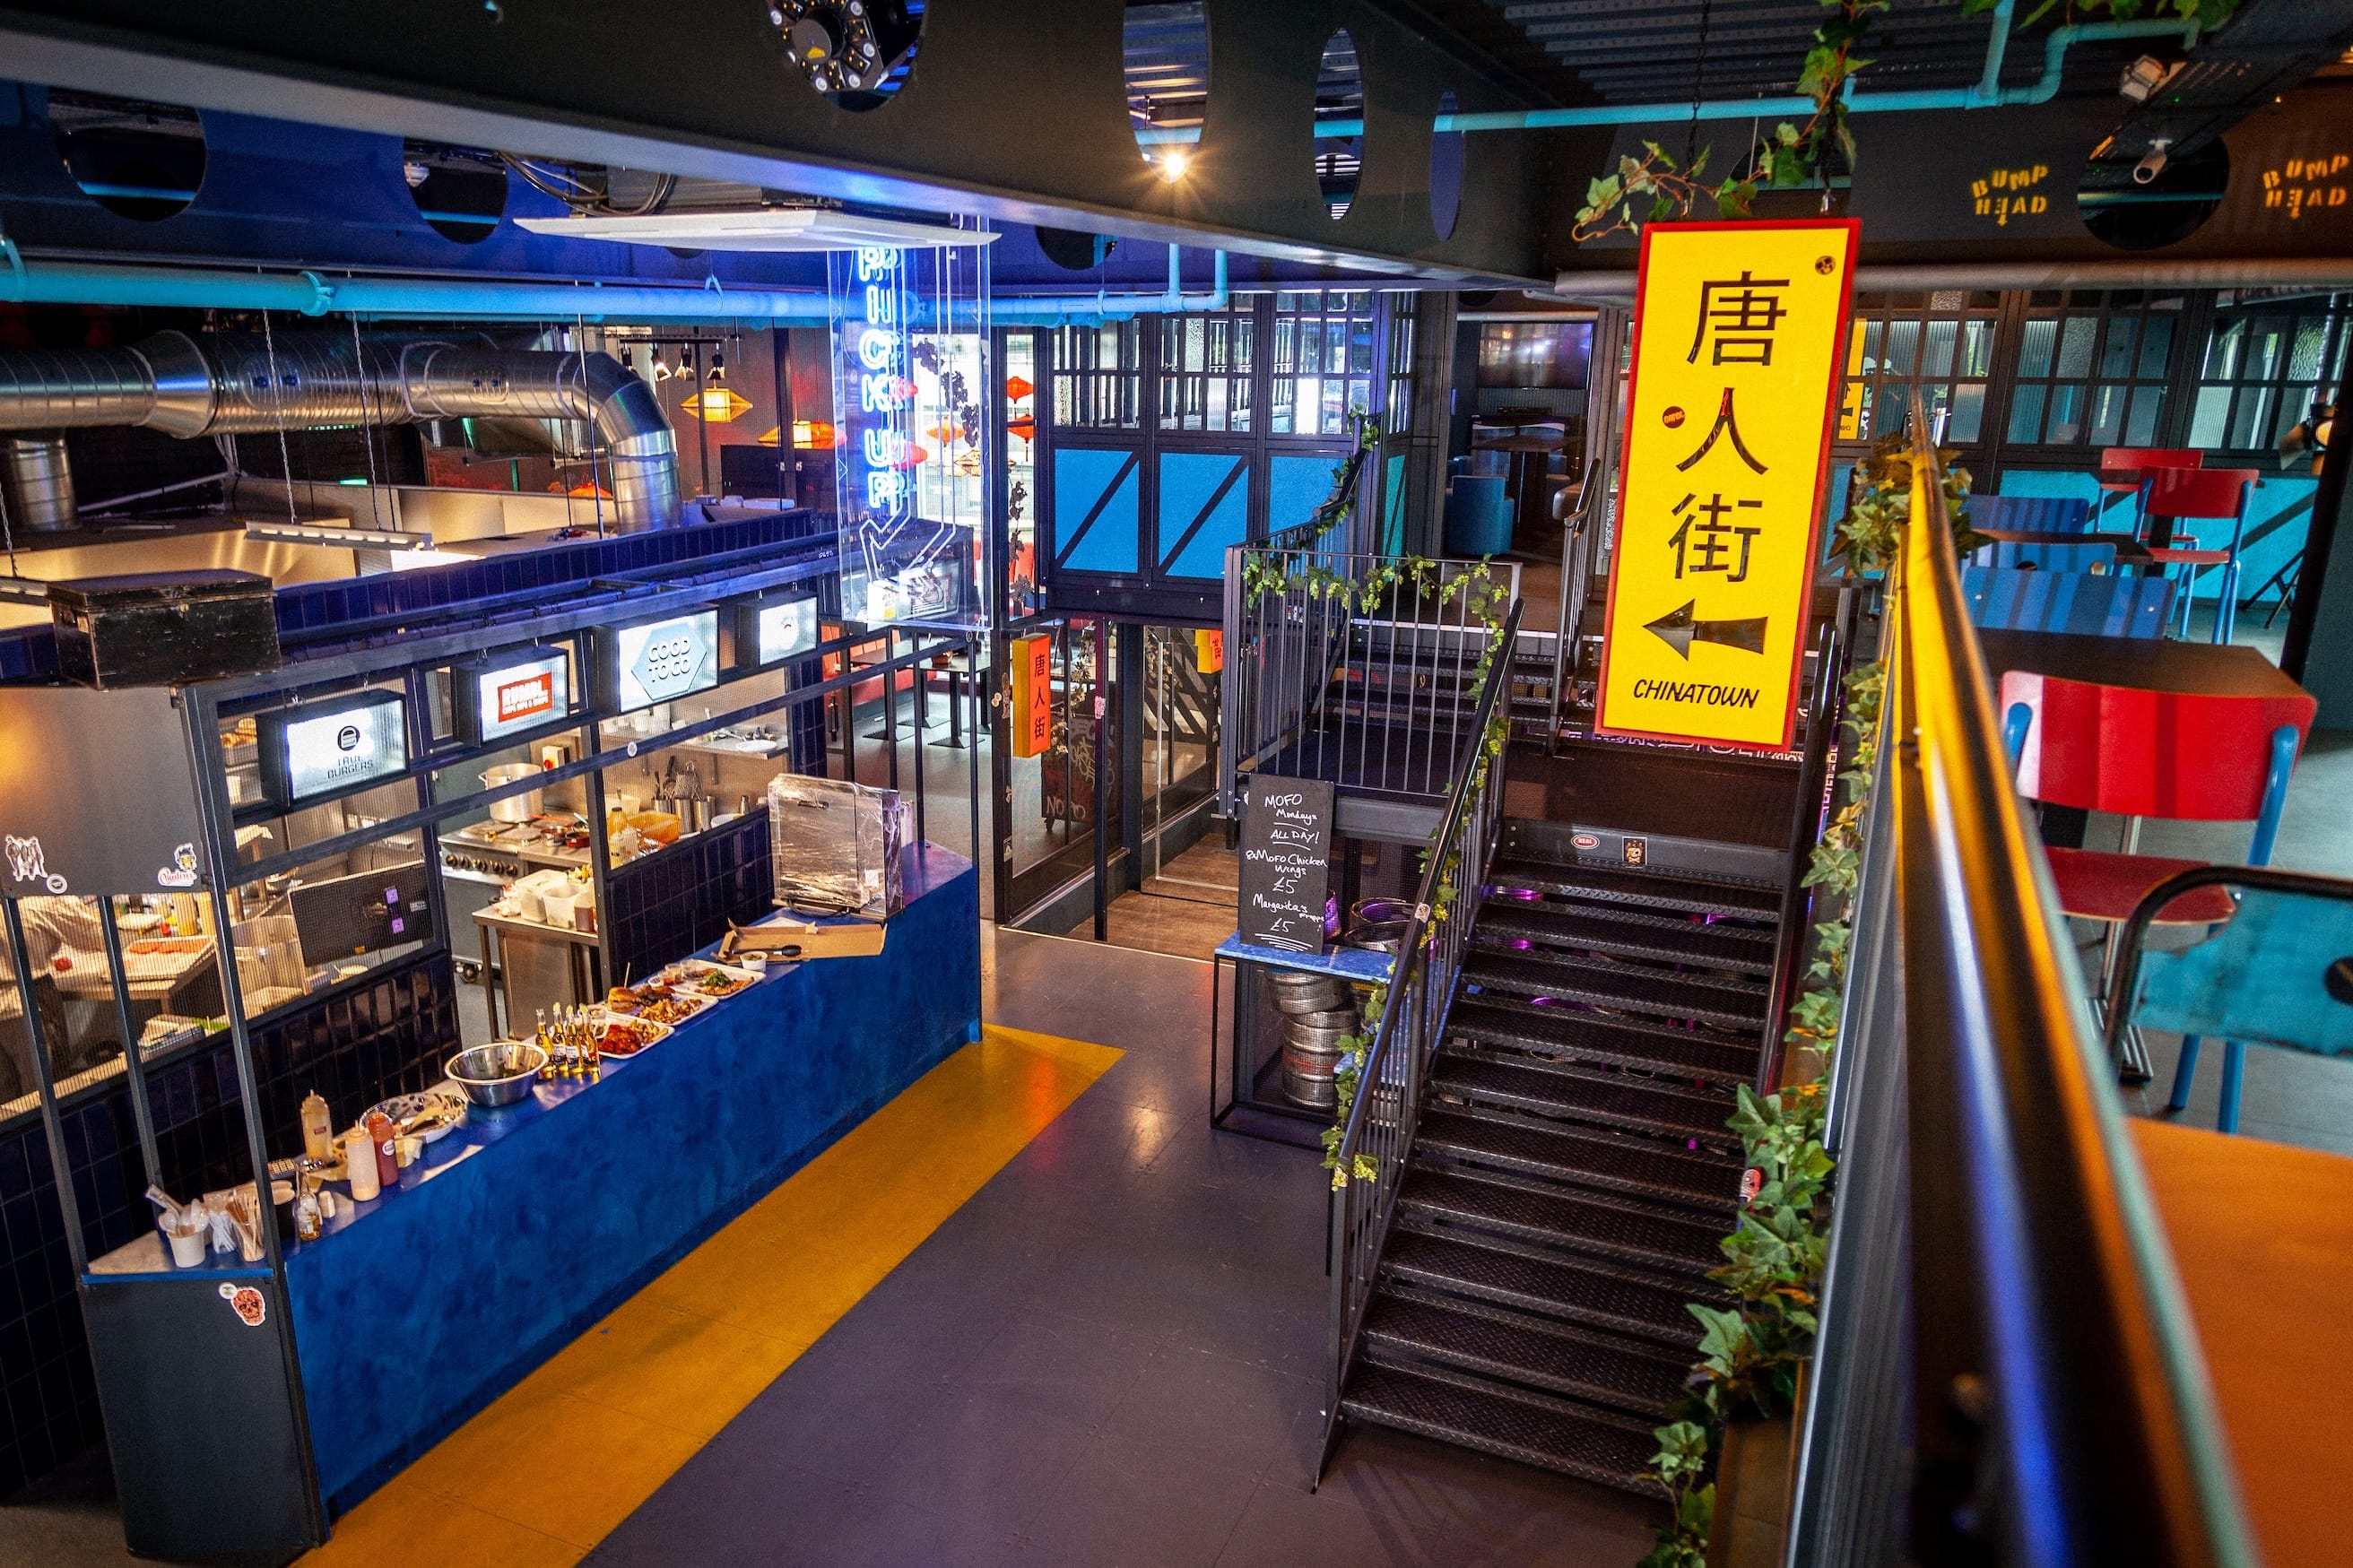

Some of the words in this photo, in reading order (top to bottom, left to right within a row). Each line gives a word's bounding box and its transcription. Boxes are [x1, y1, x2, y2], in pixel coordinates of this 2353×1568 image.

[1972, 165, 2048, 198] BUMP
[2263, 154, 2349, 189] BUMP
[858, 247, 898, 413] PICK
[1668, 270, 1790, 583] 唐人街
[1034, 654, 1046, 740] 唐人街
[1633, 679, 1759, 709] CHINATOWN
[327, 759, 374, 779] BURGERS
[1264, 793, 1303, 809] MOFO
[1270, 829, 1289, 839] ALL
[1291, 831, 1320, 844] DAY!
[1288, 853, 1328, 868] Chicken
[1272, 876, 1298, 894] £5
[1253, 893, 1308, 914] Margarita's
[1270, 917, 1296, 933] £5
